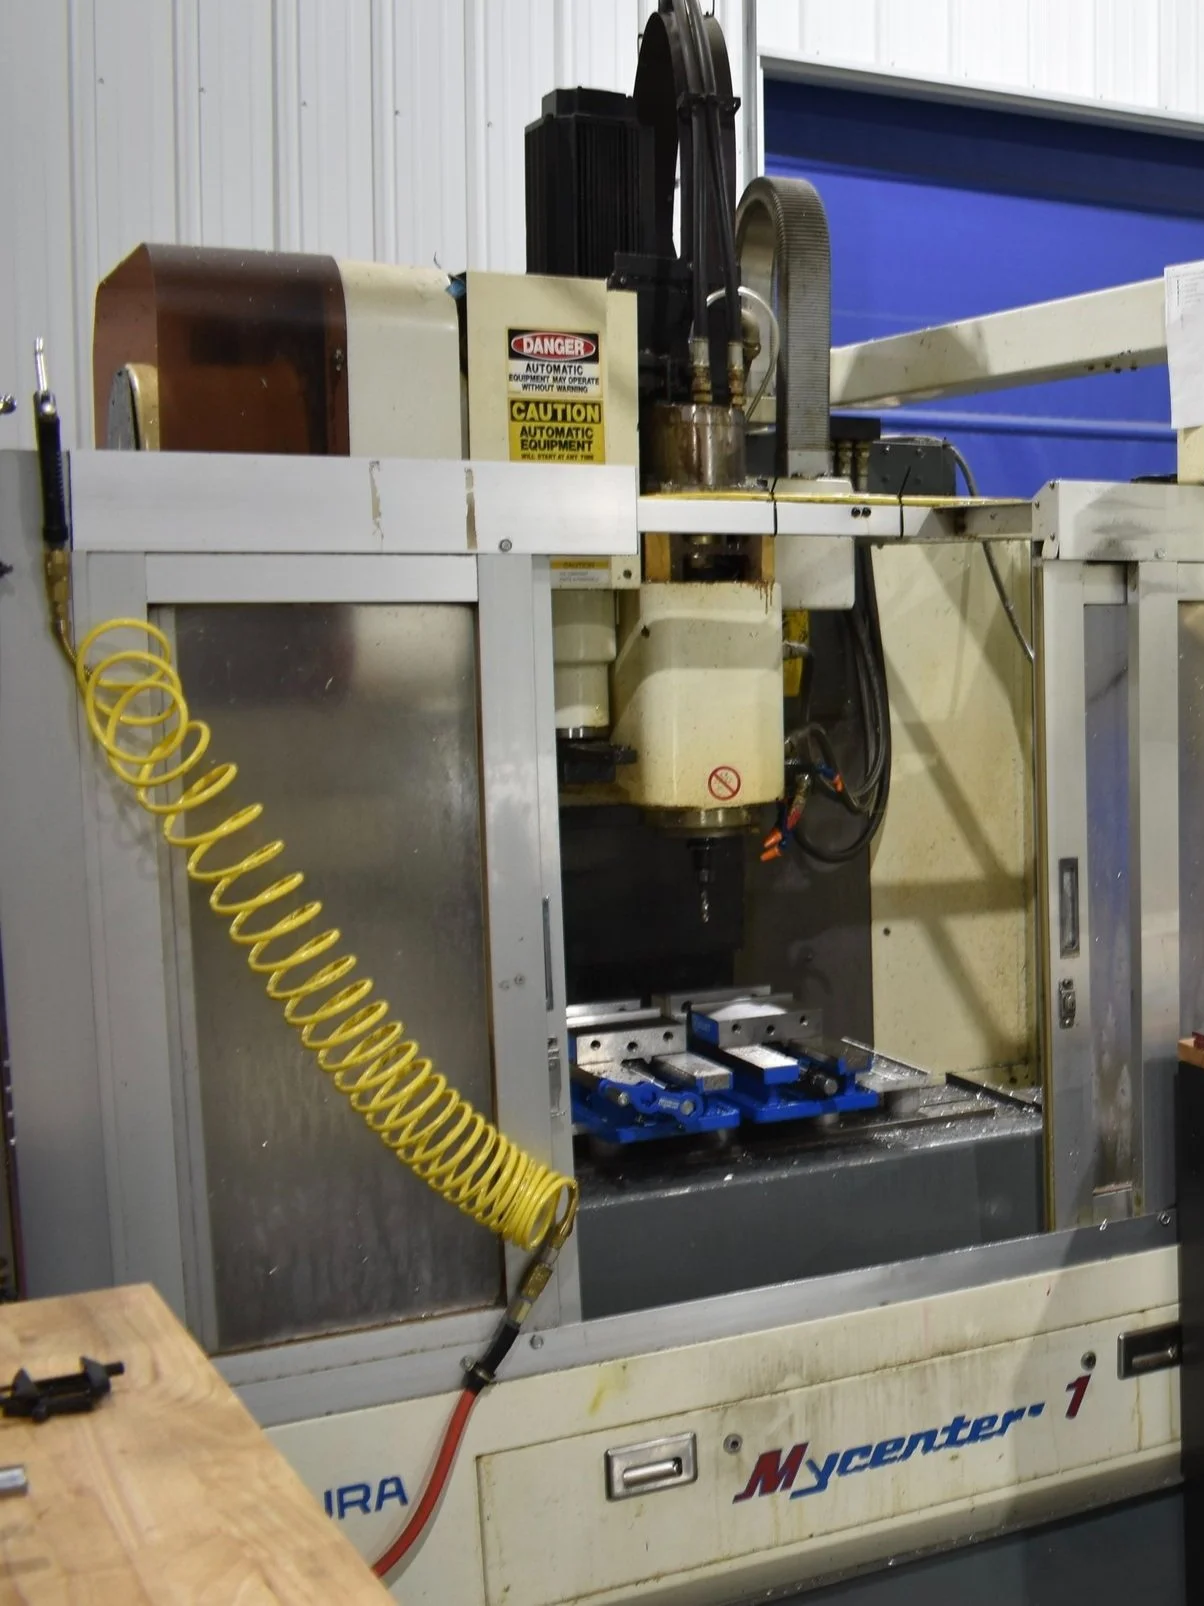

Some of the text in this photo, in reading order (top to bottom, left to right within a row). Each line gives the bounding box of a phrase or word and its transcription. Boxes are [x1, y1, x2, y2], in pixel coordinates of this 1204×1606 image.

[522, 336, 585, 356] DANGER
[525, 363, 584, 376] AUTOMATIC
[509, 374, 599, 385] EQUIPMENT MAY OPERATE
[522, 384, 588, 393] WITHOUT WARNING
[512, 402, 600, 422] CAUTION
[520, 426, 594, 439] AUTOMATIC
[521, 440, 593, 452] EQUIPMENT
